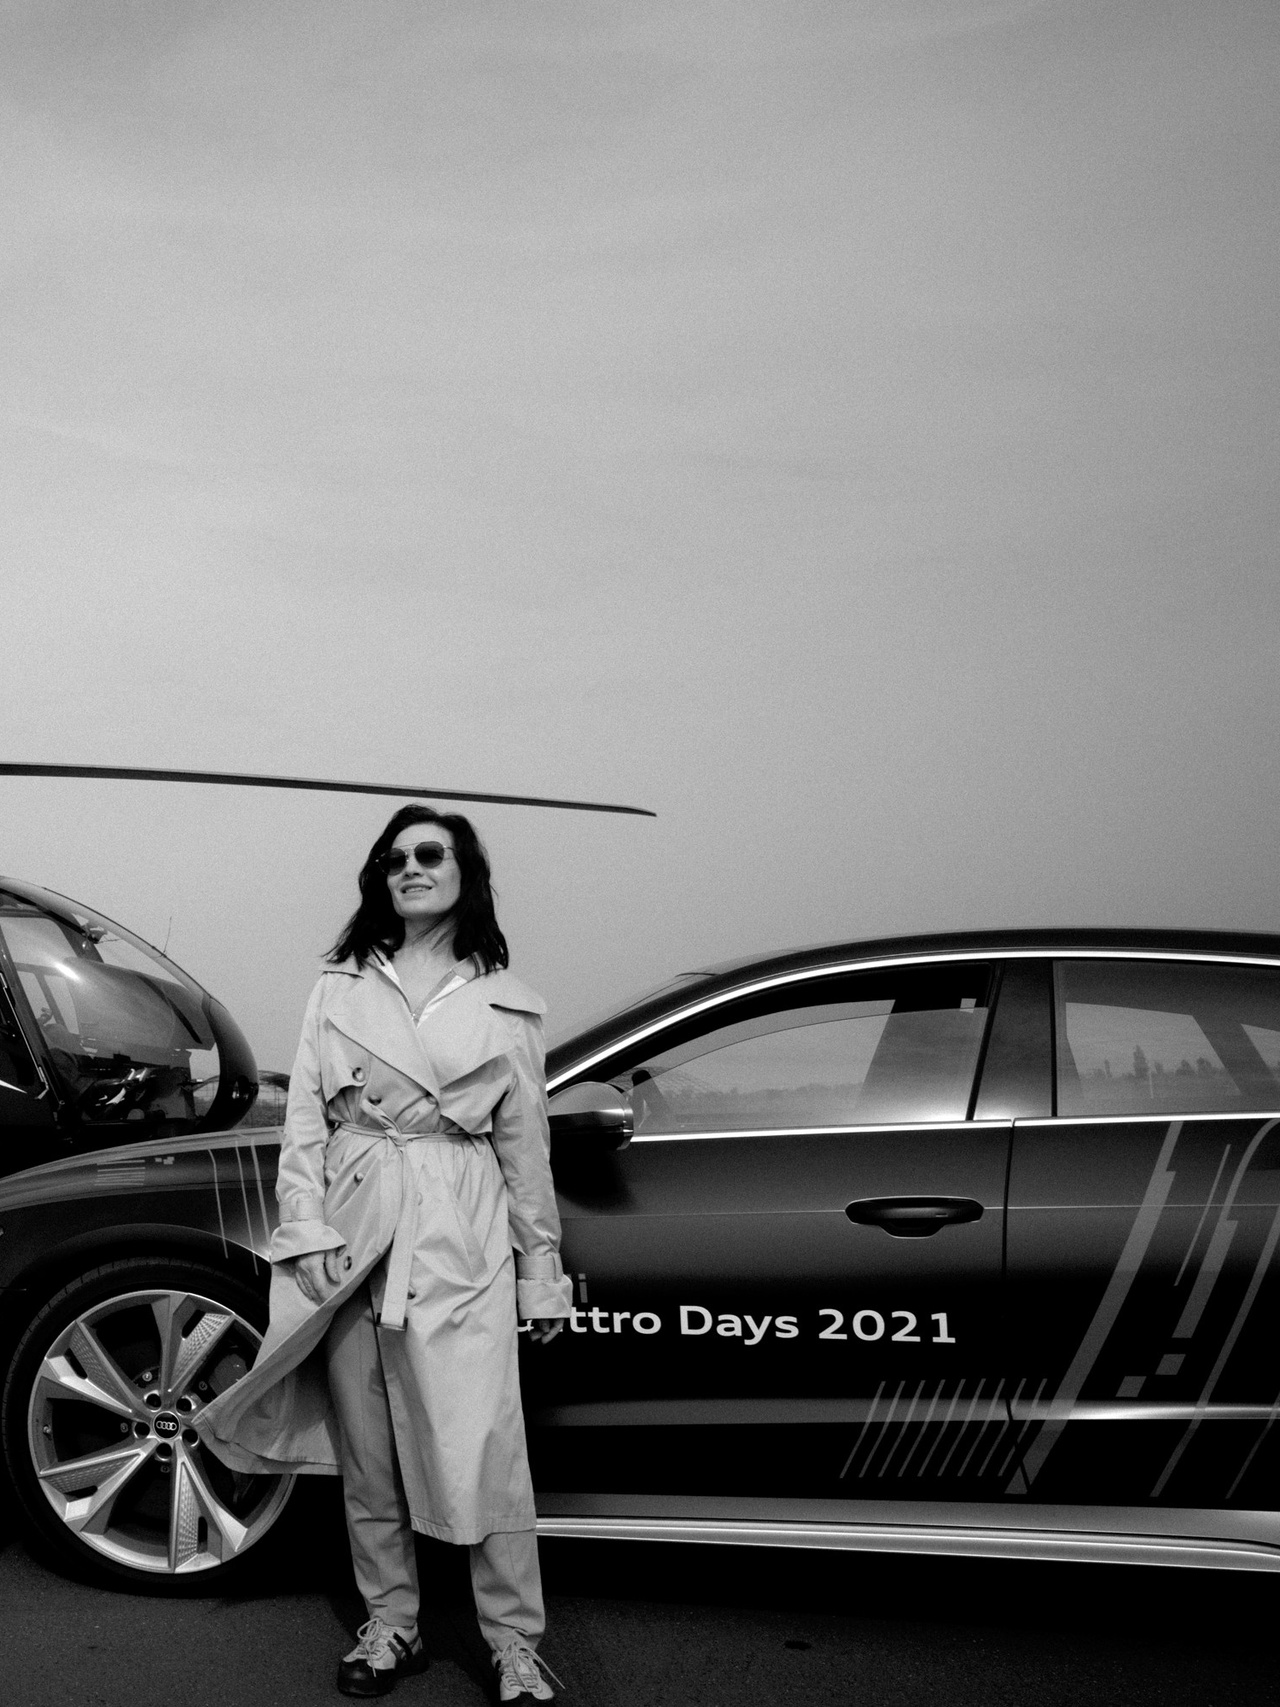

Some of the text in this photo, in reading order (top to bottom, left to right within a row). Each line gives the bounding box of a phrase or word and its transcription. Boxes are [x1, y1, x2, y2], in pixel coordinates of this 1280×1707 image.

[518, 1305, 956, 1345] ttro Days 2021
